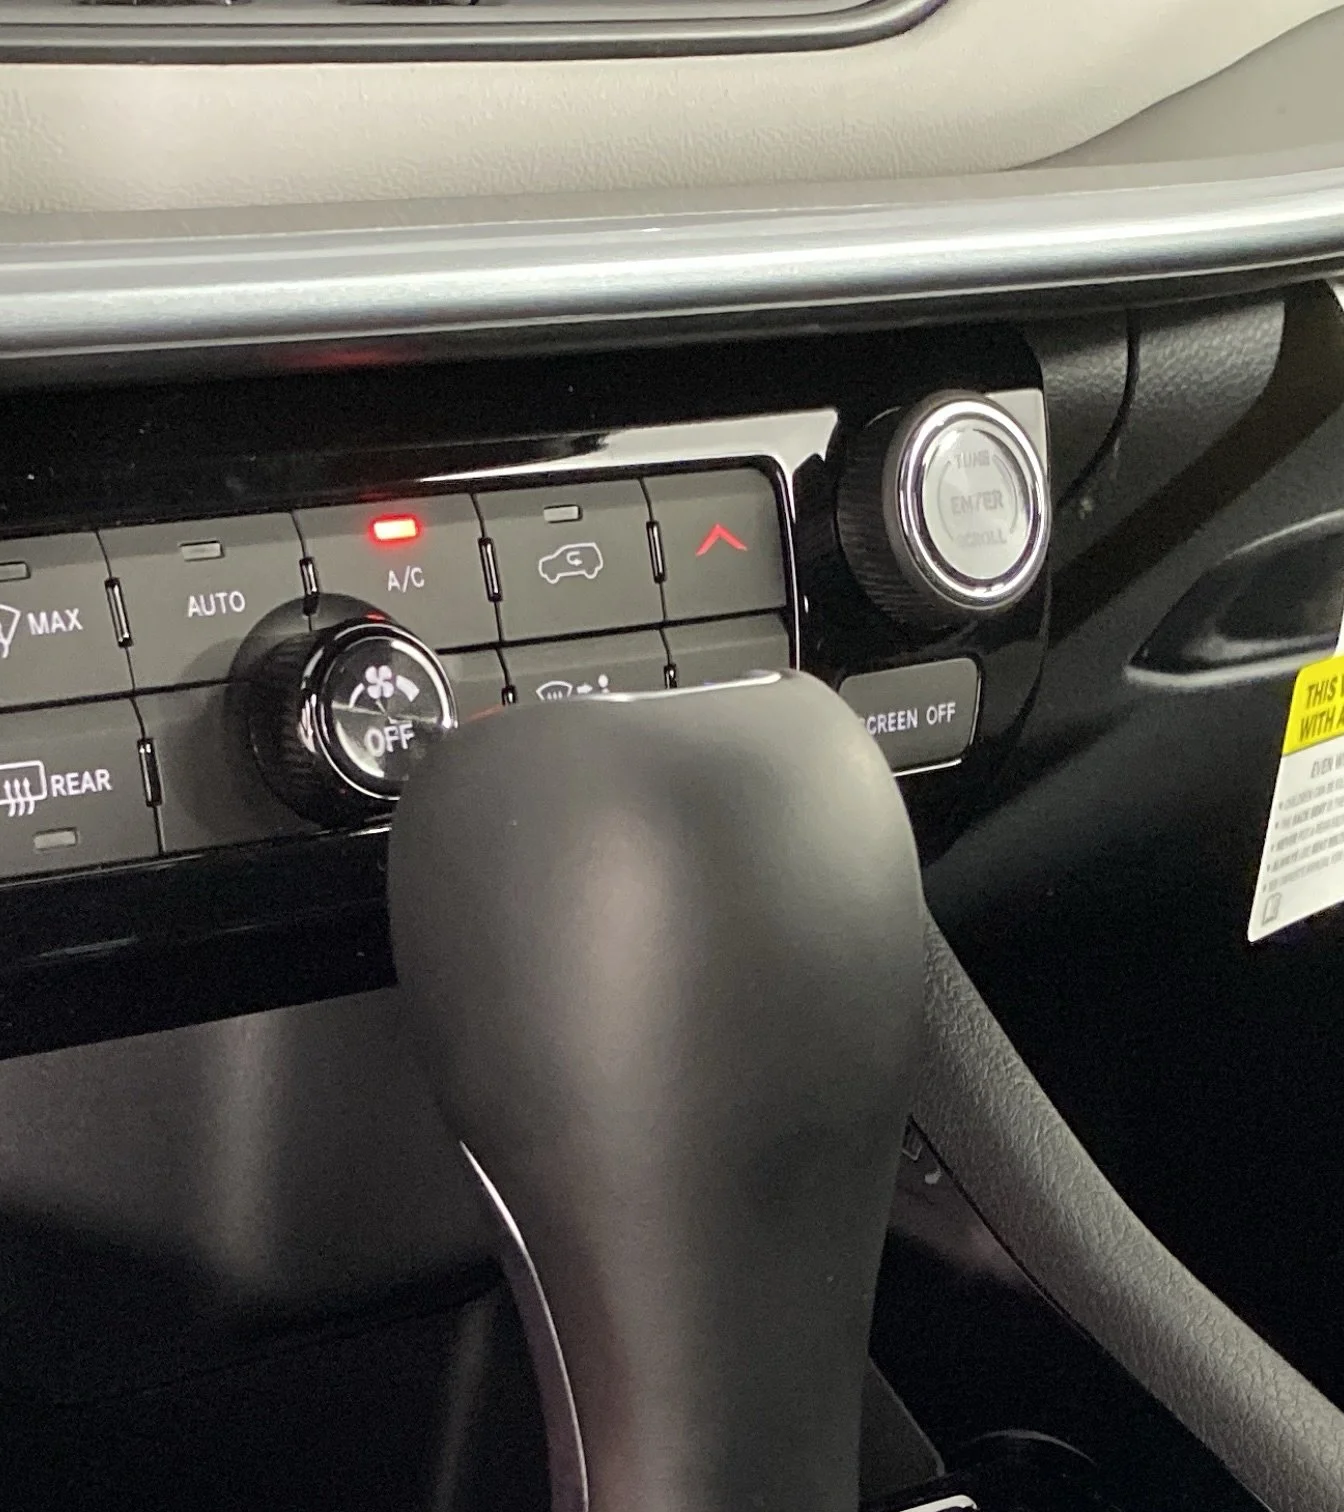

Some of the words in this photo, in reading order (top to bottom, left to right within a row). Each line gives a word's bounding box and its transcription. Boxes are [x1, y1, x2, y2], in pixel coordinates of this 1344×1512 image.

[954, 450, 991, 469] TUNE
[950, 490, 1004, 515] ENTER
[957, 529, 1008, 548] SCROLL
[387, 565, 425, 593] A/C
[187, 590, 246, 617] AUTO
[27, 608, 84, 636] MAX
[1306, 677, 1337, 709] THIS
[860, 708, 918, 736] CREEN
[926, 702, 956, 726] OFF
[1298, 709, 1334, 742] WITH
[364, 721, 416, 757] OFF
[1310, 758, 1334, 778] EVEN
[50, 768, 113, 798] REAR
